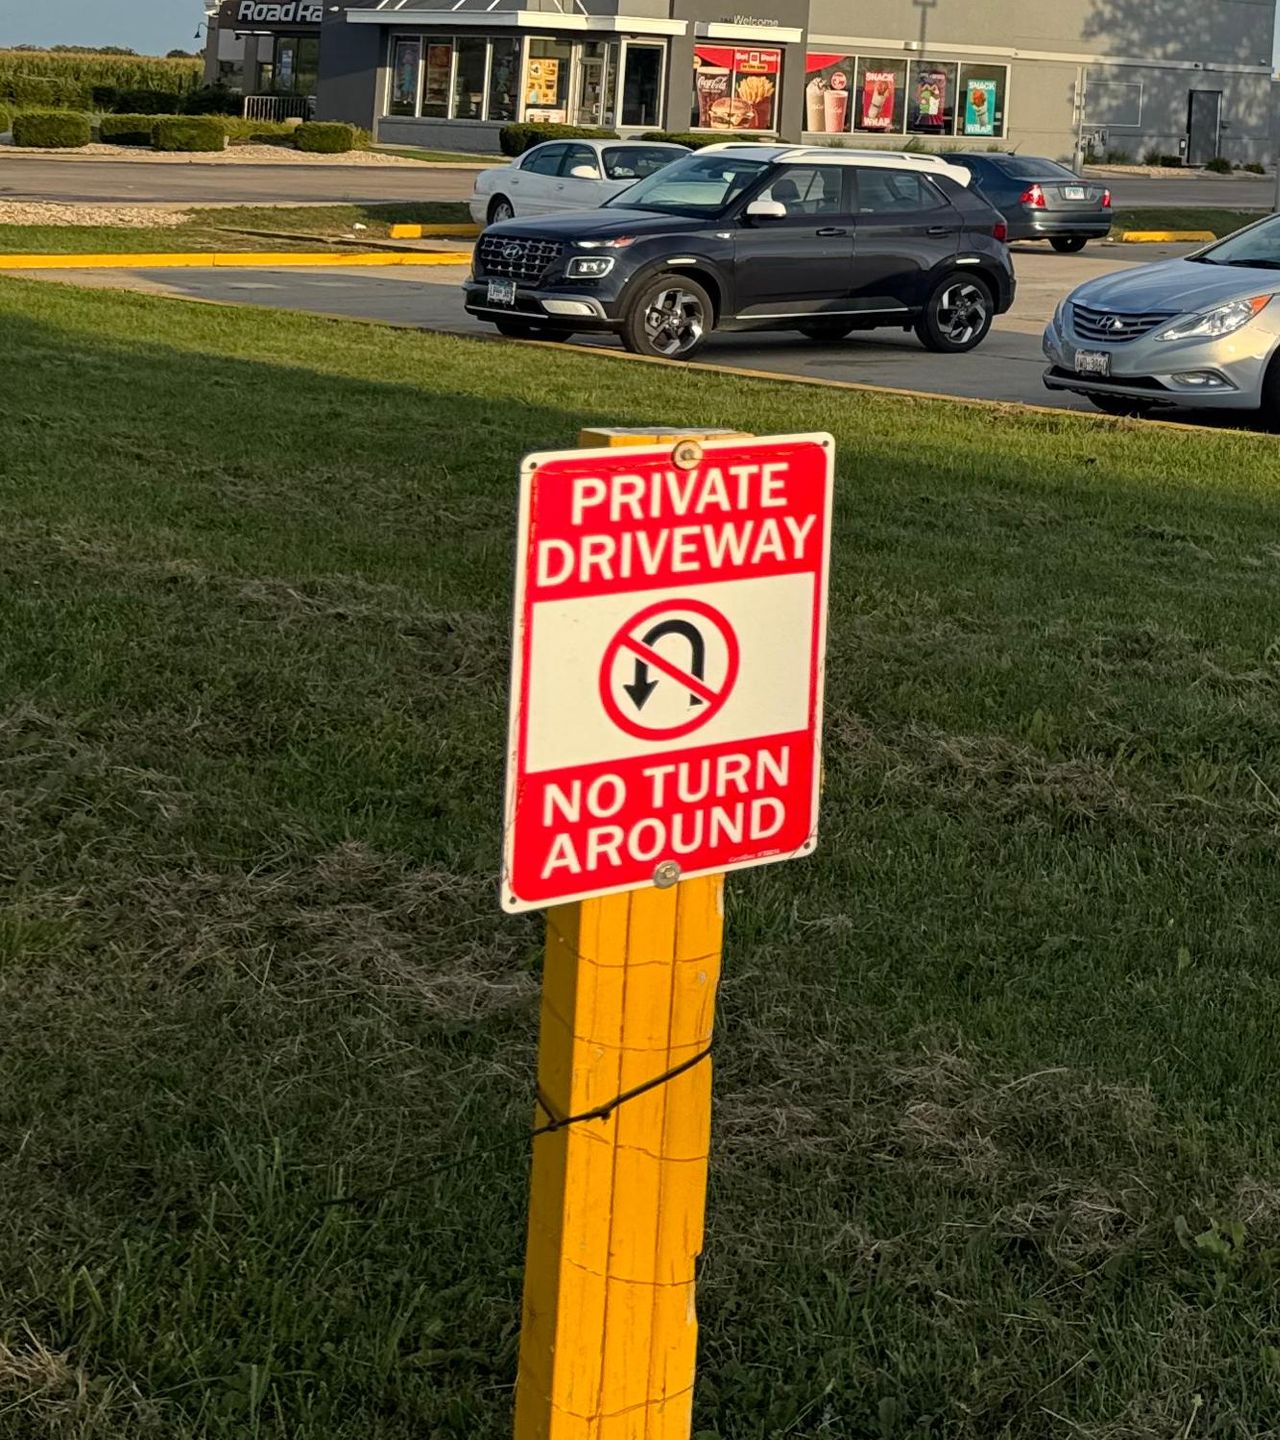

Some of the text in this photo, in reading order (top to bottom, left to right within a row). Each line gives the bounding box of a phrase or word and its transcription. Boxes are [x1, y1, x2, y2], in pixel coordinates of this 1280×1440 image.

[237, 0, 296, 21] Road
[571, 462, 789, 526] PRIVATE
[537, 514, 816, 588] DRIVEWAY
[543, 745, 789, 827] NO TURN
[541, 796, 786, 880] AROUND
